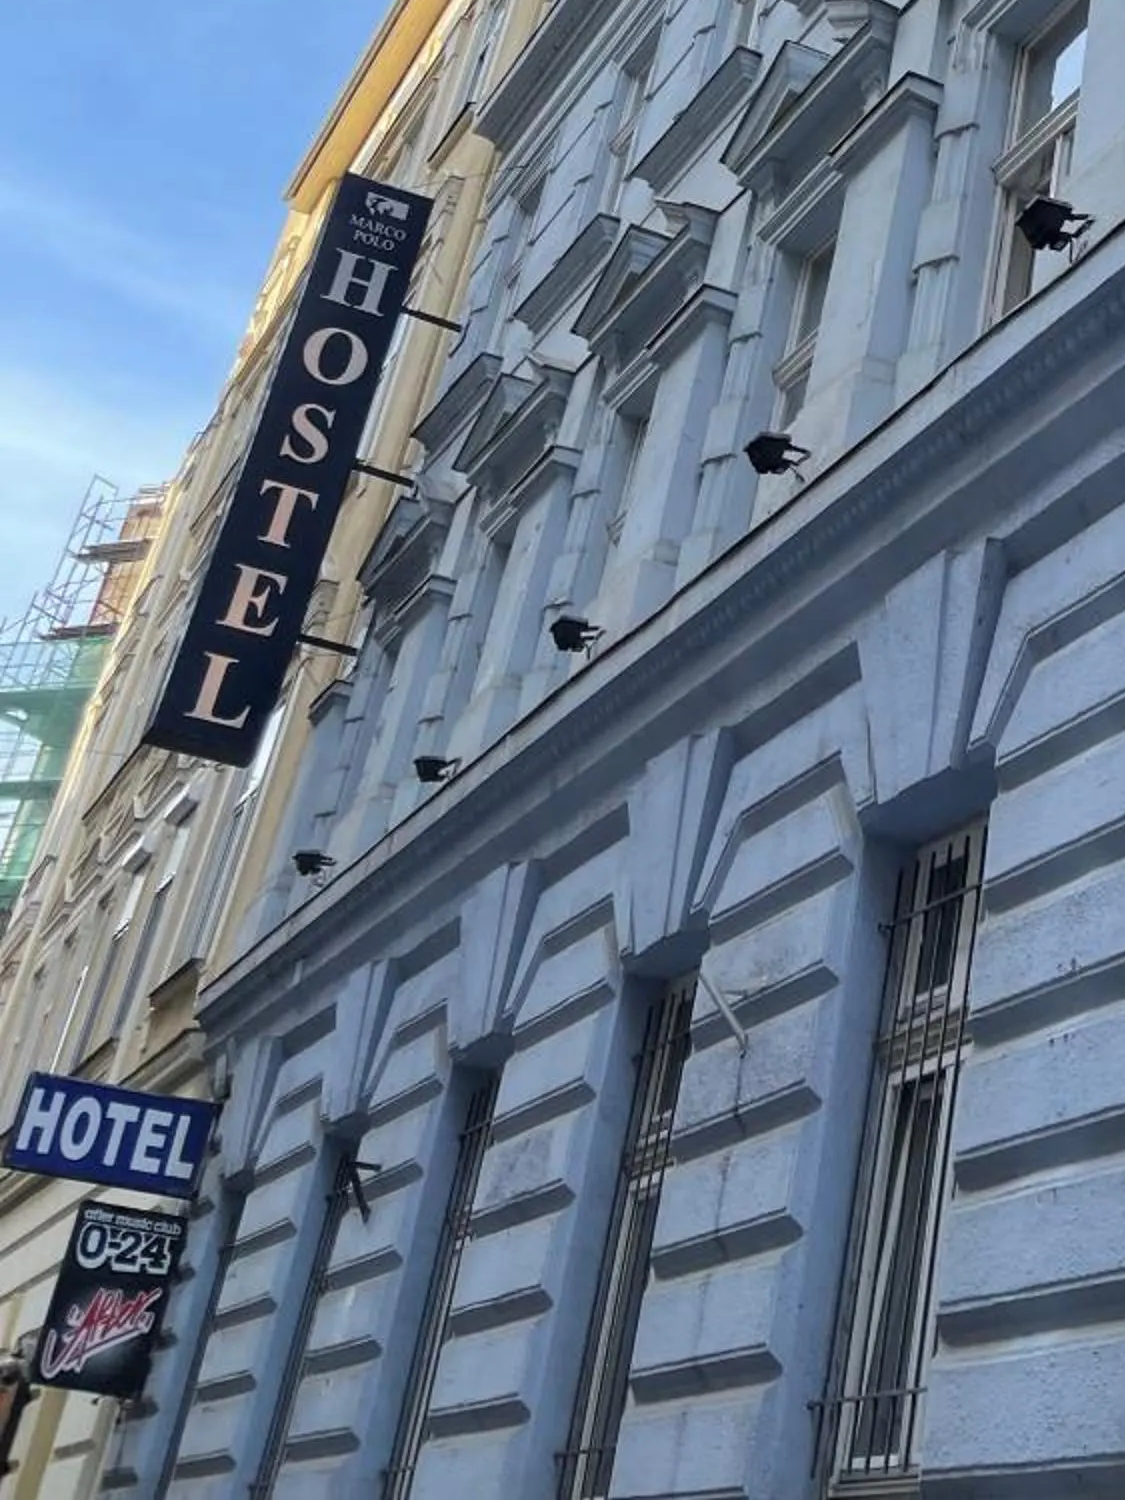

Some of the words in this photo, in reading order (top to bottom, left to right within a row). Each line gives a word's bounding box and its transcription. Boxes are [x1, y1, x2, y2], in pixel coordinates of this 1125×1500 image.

[349, 213, 407, 241] MARCO
[353, 229, 395, 251] POLO
[184, 247, 399, 730] HOSTEL
[15, 1087, 194, 1179] HOTEL
[76, 1221, 171, 1275] 0-24
